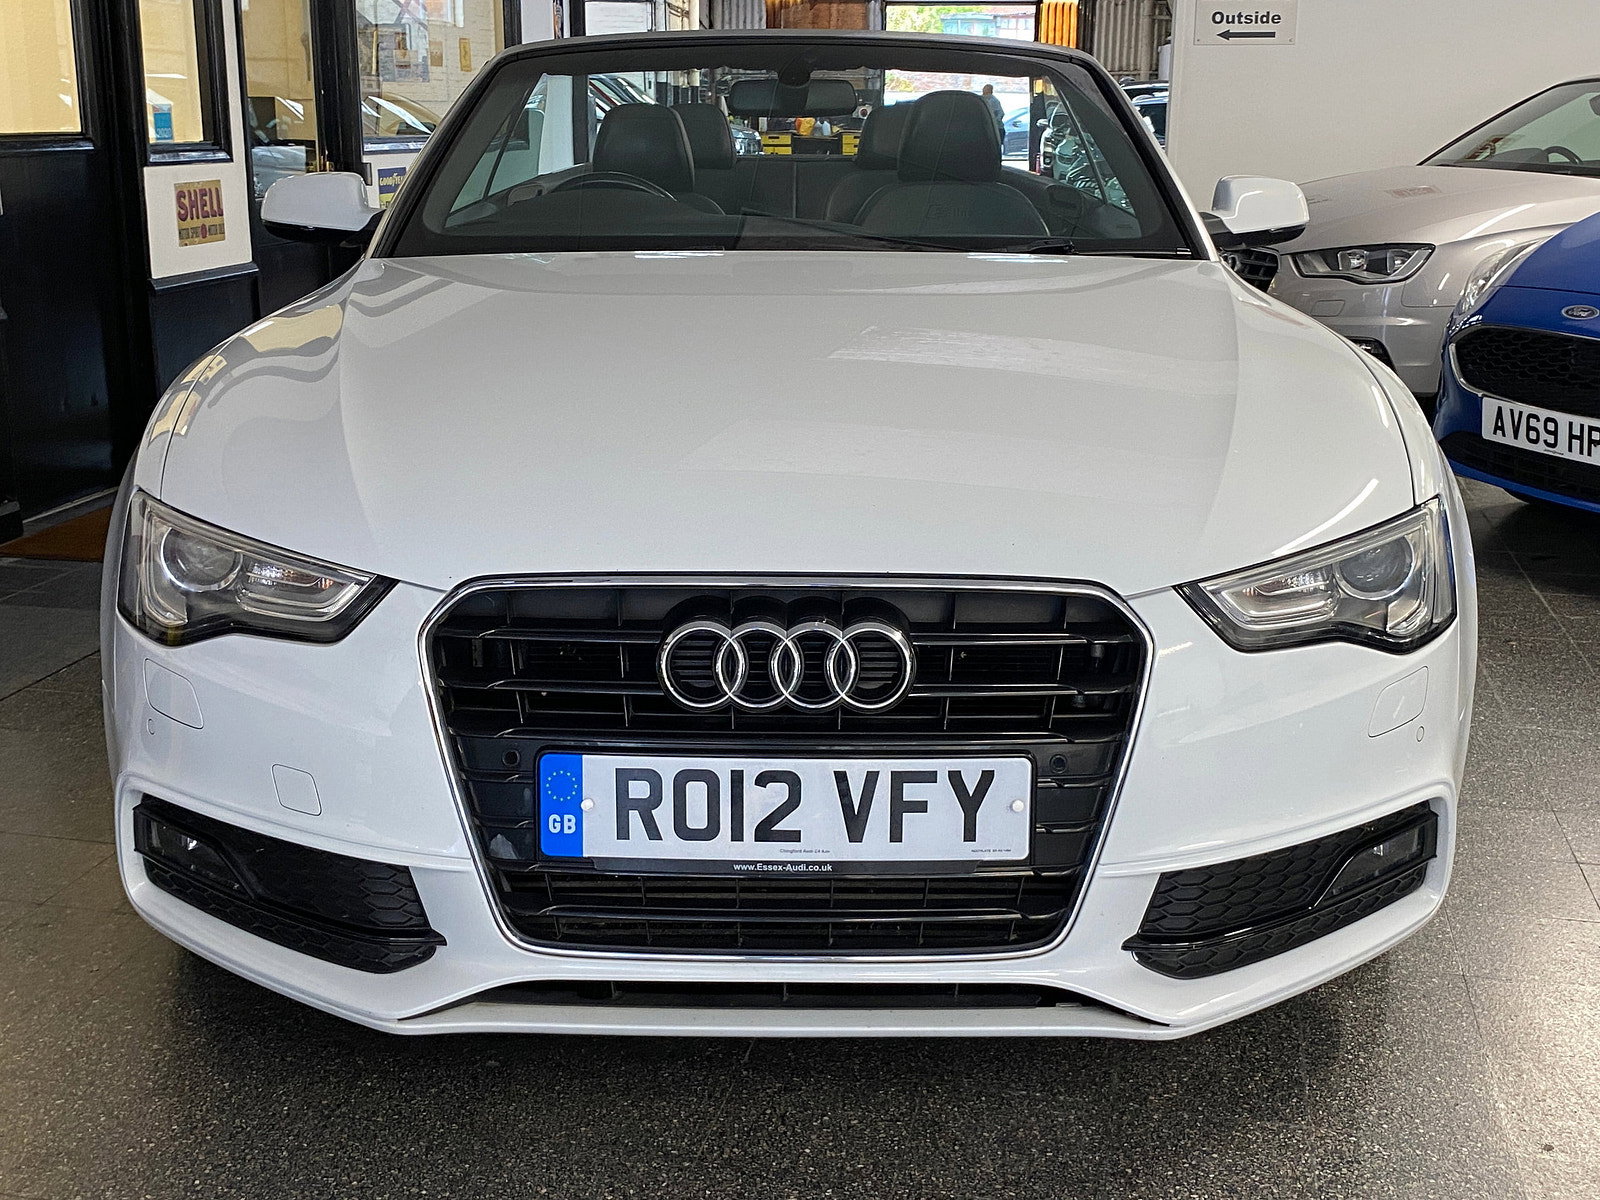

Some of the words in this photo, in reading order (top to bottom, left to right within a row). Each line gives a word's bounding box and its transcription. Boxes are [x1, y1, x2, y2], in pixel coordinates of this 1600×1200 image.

[1211, 11, 1281, 24] Outside
[176, 187, 224, 222] SHELL
[1493, 405, 1559, 449] AV69
[833, 769, 995, 843] VFY
[549, 814, 577, 834] GB
[733, 862, 833, 872] www.Essex-Audi.co.uk
